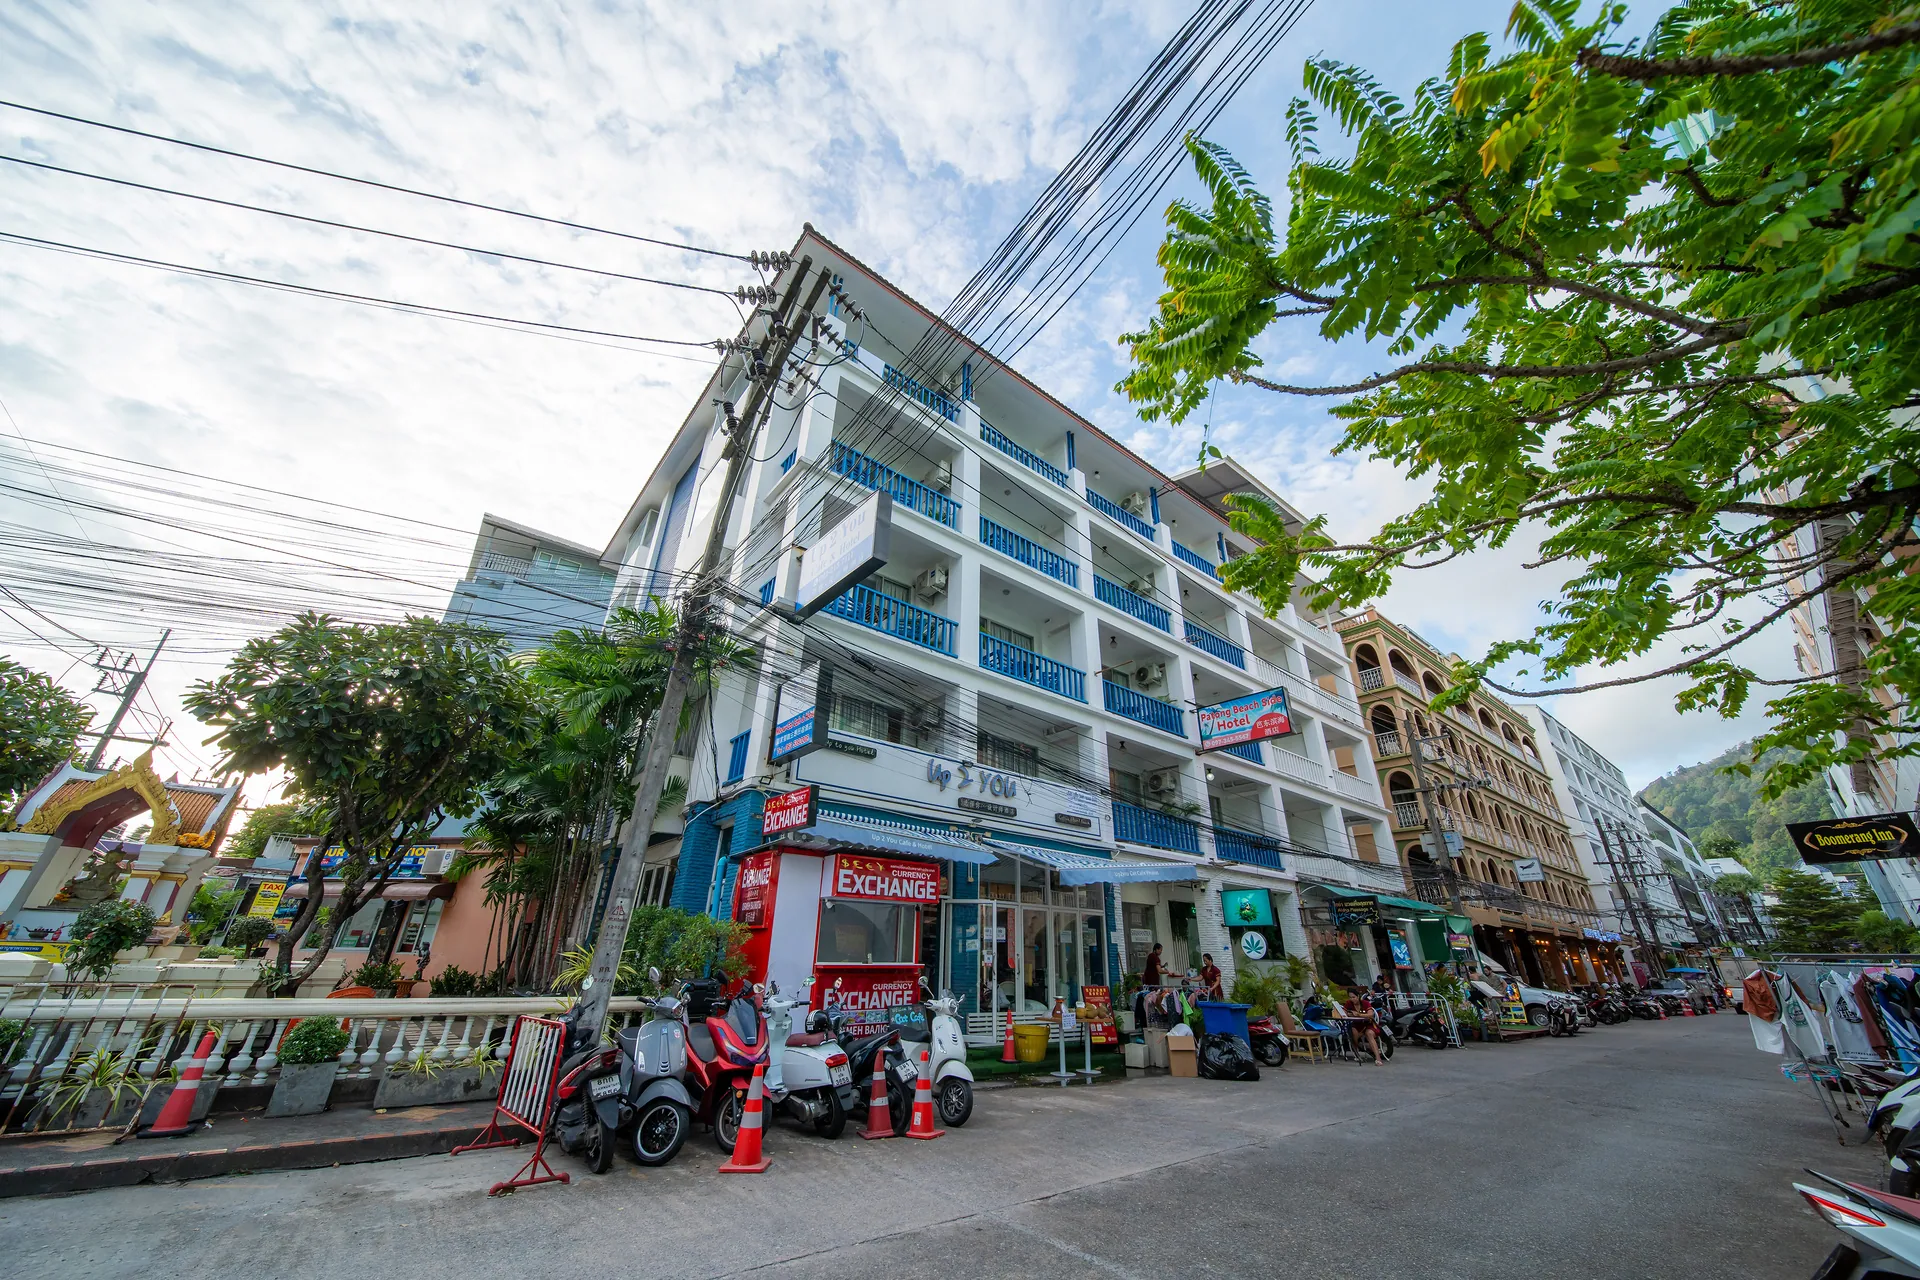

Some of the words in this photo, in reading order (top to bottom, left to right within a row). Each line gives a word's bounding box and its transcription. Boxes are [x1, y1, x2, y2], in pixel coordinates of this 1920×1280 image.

[1200, 708, 1231, 722] Patong
[1232, 701, 1260, 714] Beach
[1261, 694, 1283, 707] Side
[1217, 713, 1251, 731] Hotel
[957, 765, 973, 789] 2
[763, 803, 809, 833] EXCHANGE
[886, 836, 898, 844] You
[1815, 832, 1876, 847] Boomerang
[1872, 828, 1895, 841] Inn
[837, 868, 937, 900] EXCHANGE
[891, 869, 932, 880] CURRENCY
[262, 883, 284, 891] TAXI
[823, 988, 914, 1010] EXCHANGE
